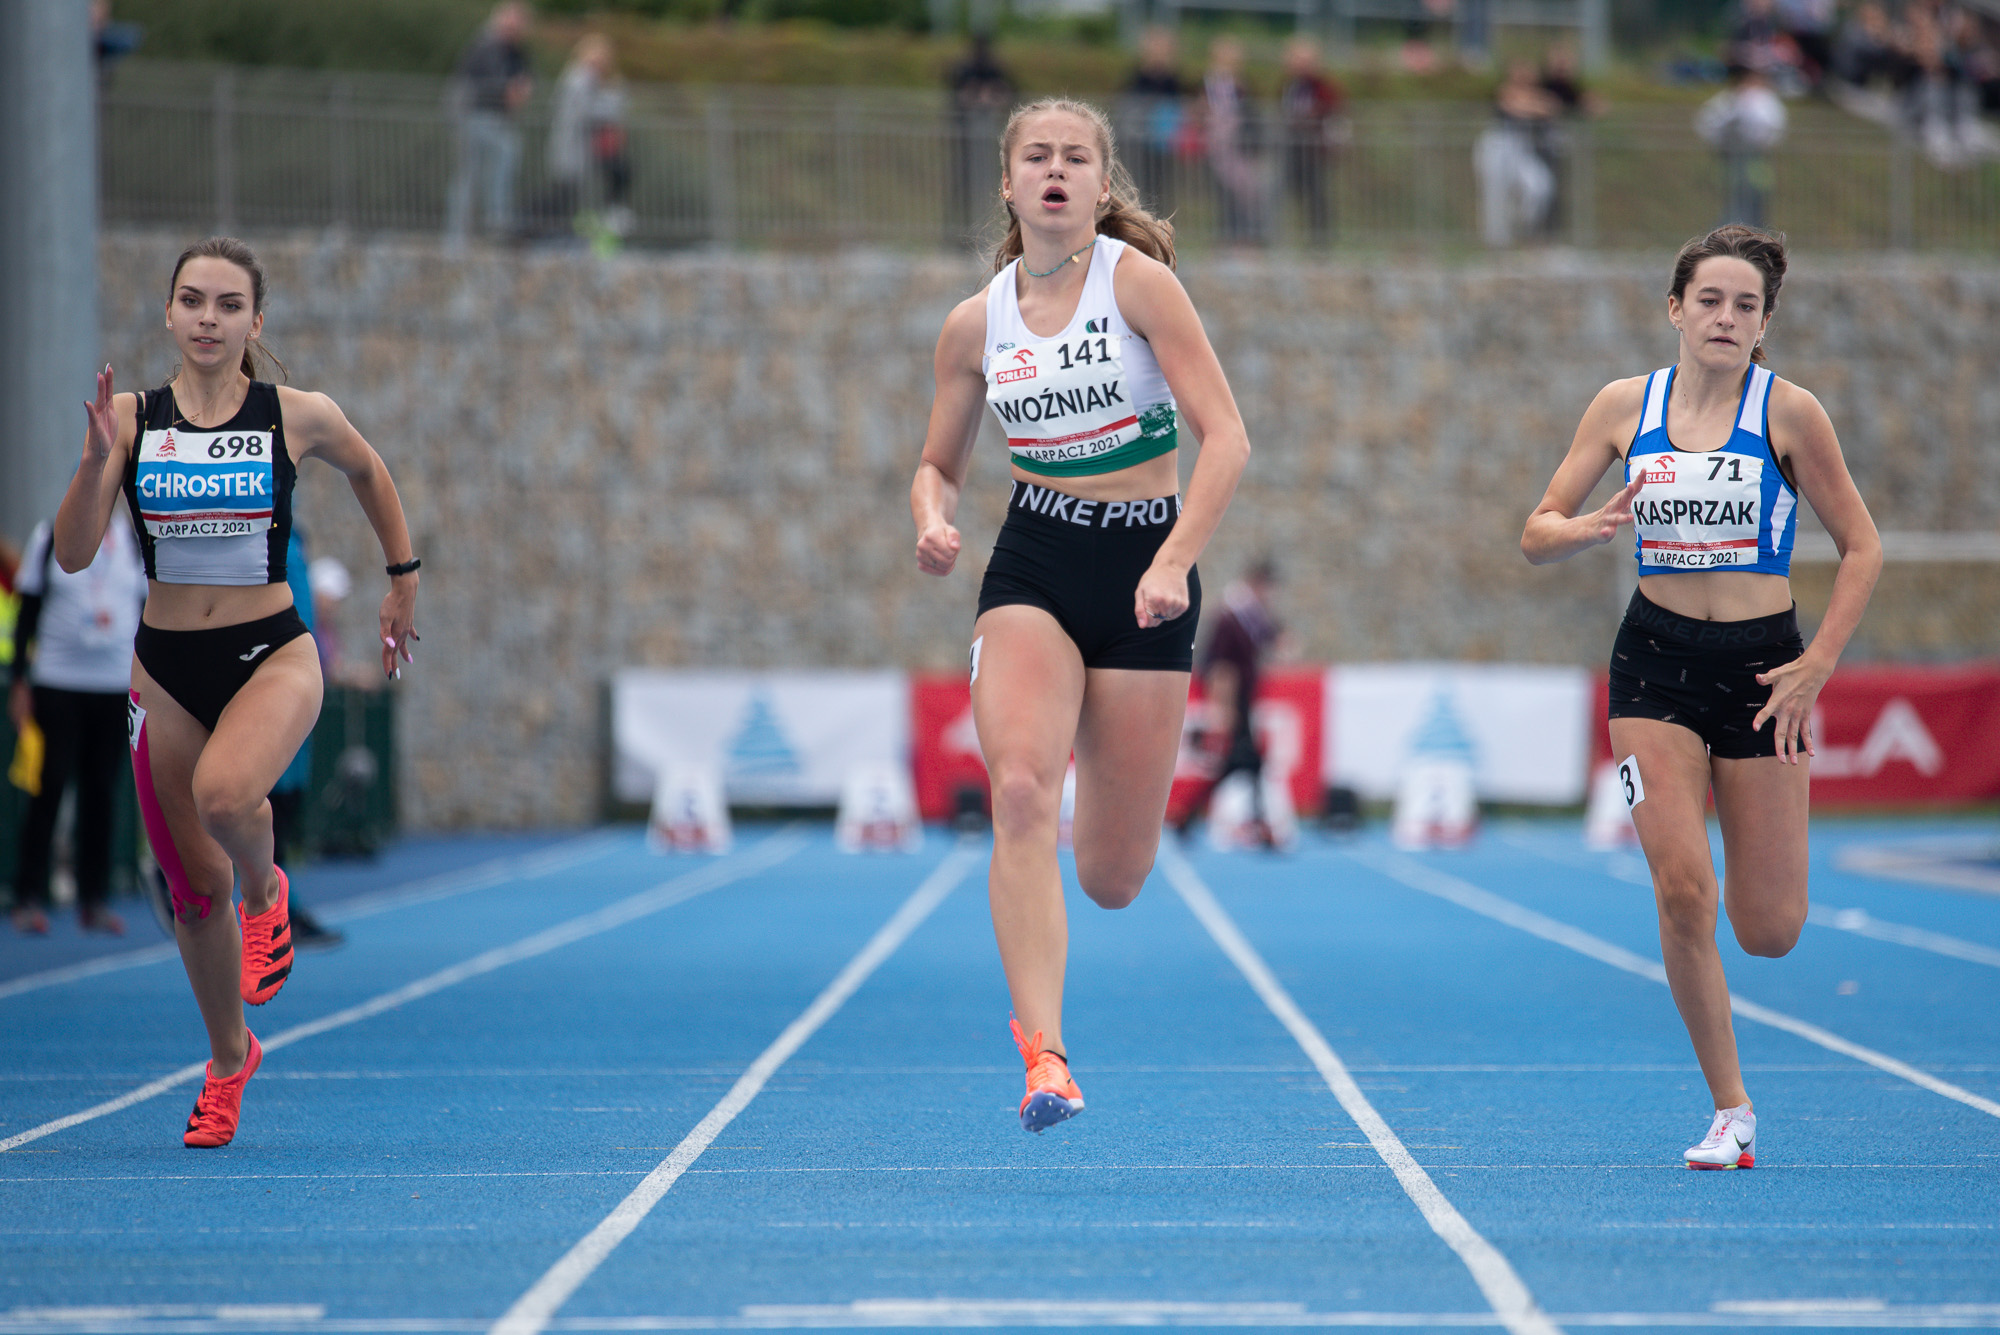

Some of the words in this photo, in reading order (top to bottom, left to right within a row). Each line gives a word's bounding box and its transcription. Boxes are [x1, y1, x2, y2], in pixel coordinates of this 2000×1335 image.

[1057, 337, 1111, 370] 141
[998, 367, 1035, 383] ORLEN
[994, 380, 1124, 424] WOŹNIAK
[207, 435, 263, 459] 698
[1026, 444, 1086, 461] KARPACZ
[1089, 434, 1121, 454] 2021
[1645, 472, 1674, 483] RLEN
[1707, 456, 1743, 481] 71
[139, 472, 266, 498] CHROSTEK
[1019, 483, 1098, 527] NIKE
[1100, 497, 1168, 528] PRO
[1634, 499, 1755, 526] KASPRZAK
[158, 522, 218, 536] KARPACZ
[222, 521, 251, 534] 2021
[1653, 551, 1706, 566] KARPACZ
[1709, 551, 1738, 565] 2021
[1632, 599, 1695, 640] NIKE
[1697, 623, 1767, 645] PRO
[1811, 697, 1945, 778] LA
[1619, 764, 1635, 807] 3
